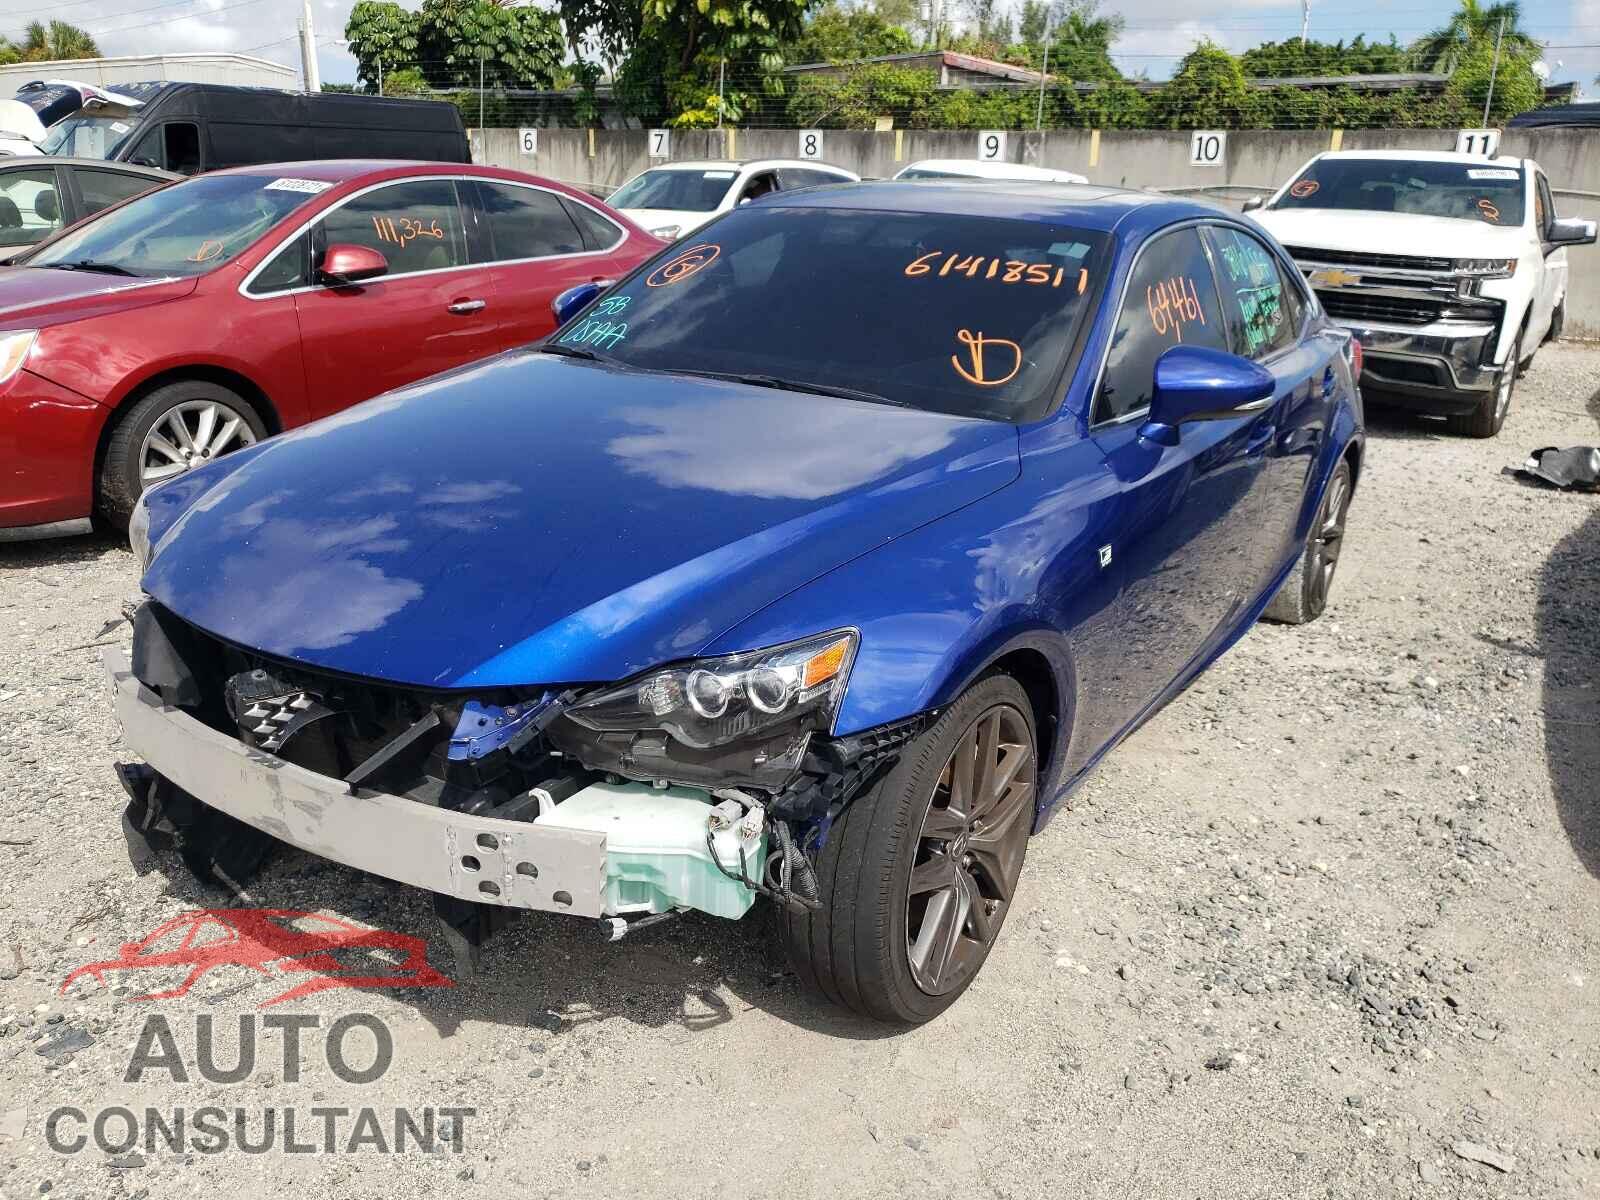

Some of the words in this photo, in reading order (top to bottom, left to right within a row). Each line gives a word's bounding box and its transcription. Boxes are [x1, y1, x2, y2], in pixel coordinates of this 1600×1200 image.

[524, 132, 533, 151] 6
[654, 133, 665, 153] 7
[805, 134, 817, 156] 8
[986, 135, 999, 158] 9
[1195, 135, 1220, 161] 10
[1465, 135, 1490, 155] 11
[904, 251, 1088, 296] 61418511
